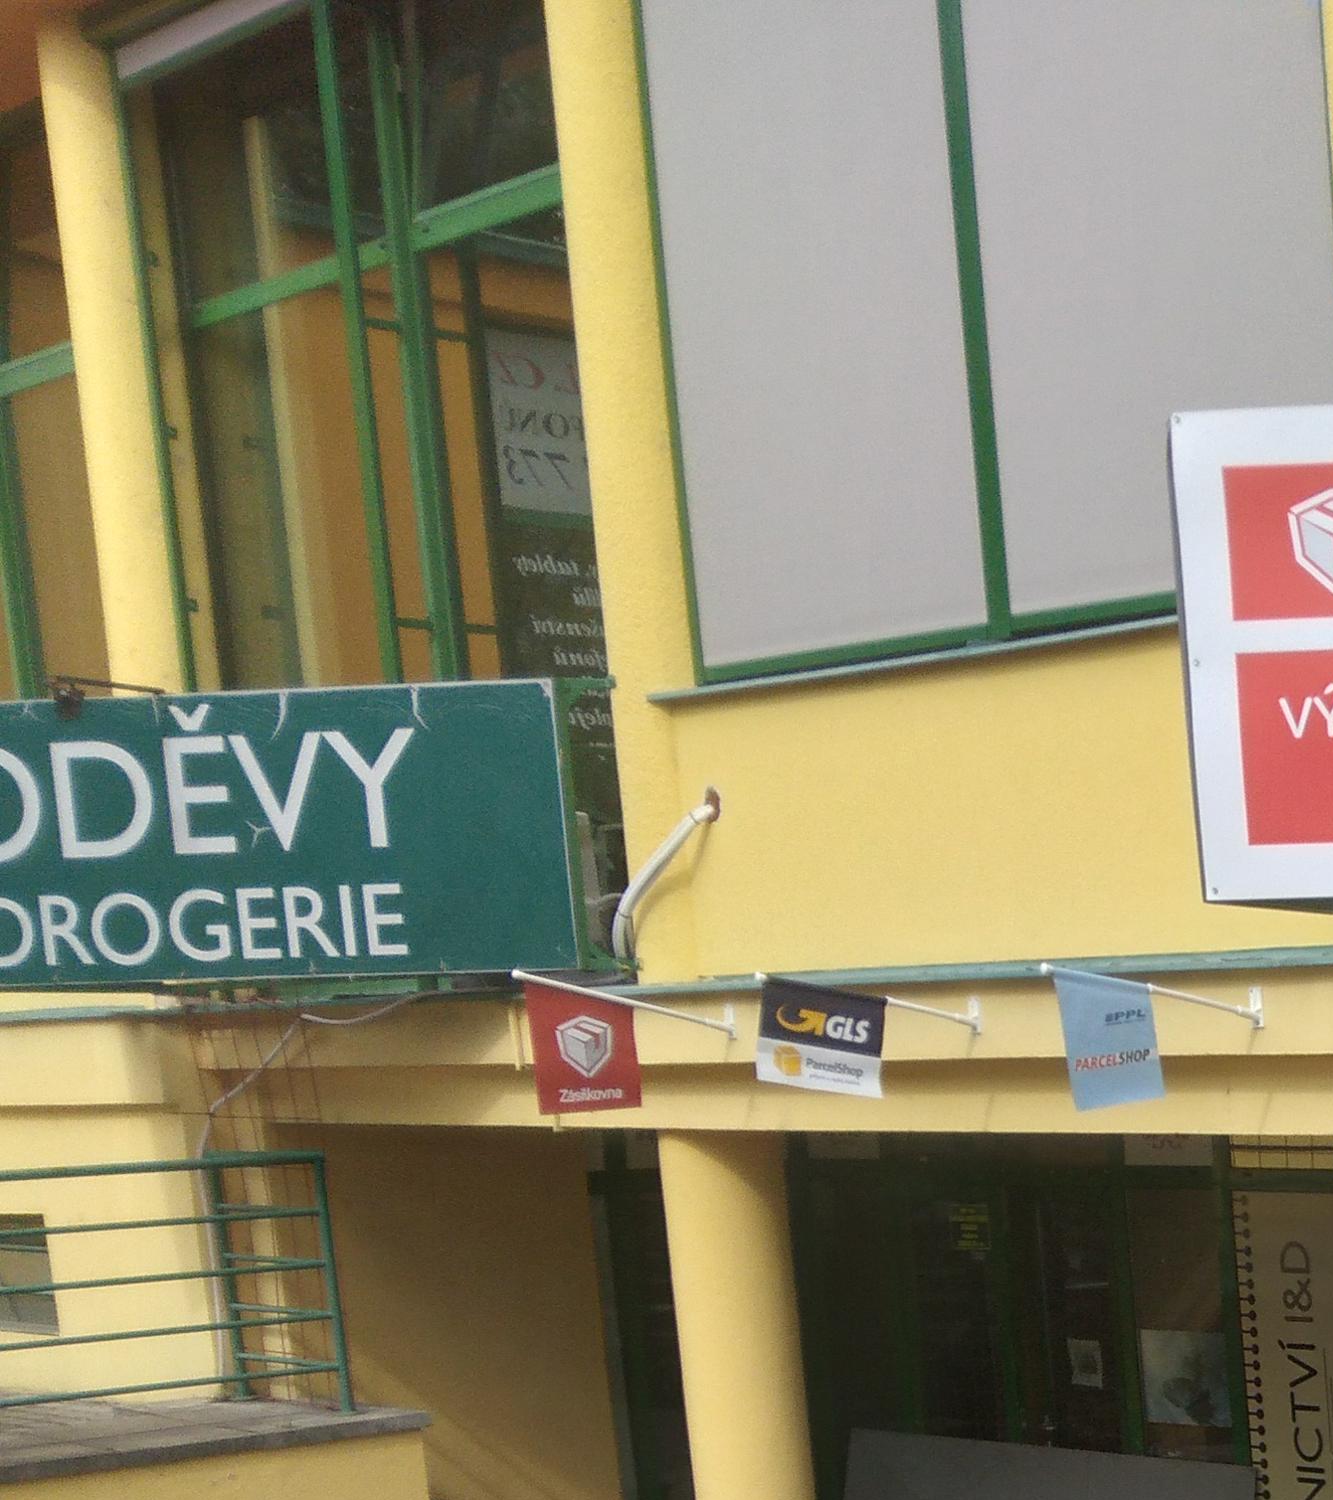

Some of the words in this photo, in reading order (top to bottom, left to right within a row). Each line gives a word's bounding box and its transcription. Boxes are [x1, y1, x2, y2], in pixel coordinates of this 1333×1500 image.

[1114, 1008, 1147, 1021] PPL
[826, 1015, 870, 1044] GLS
[805, 1057, 864, 1079] ParcelShop
[1075, 1049, 1150, 1072] PARCELSHOP
[558, 1087, 624, 1103] Zásilkovna
